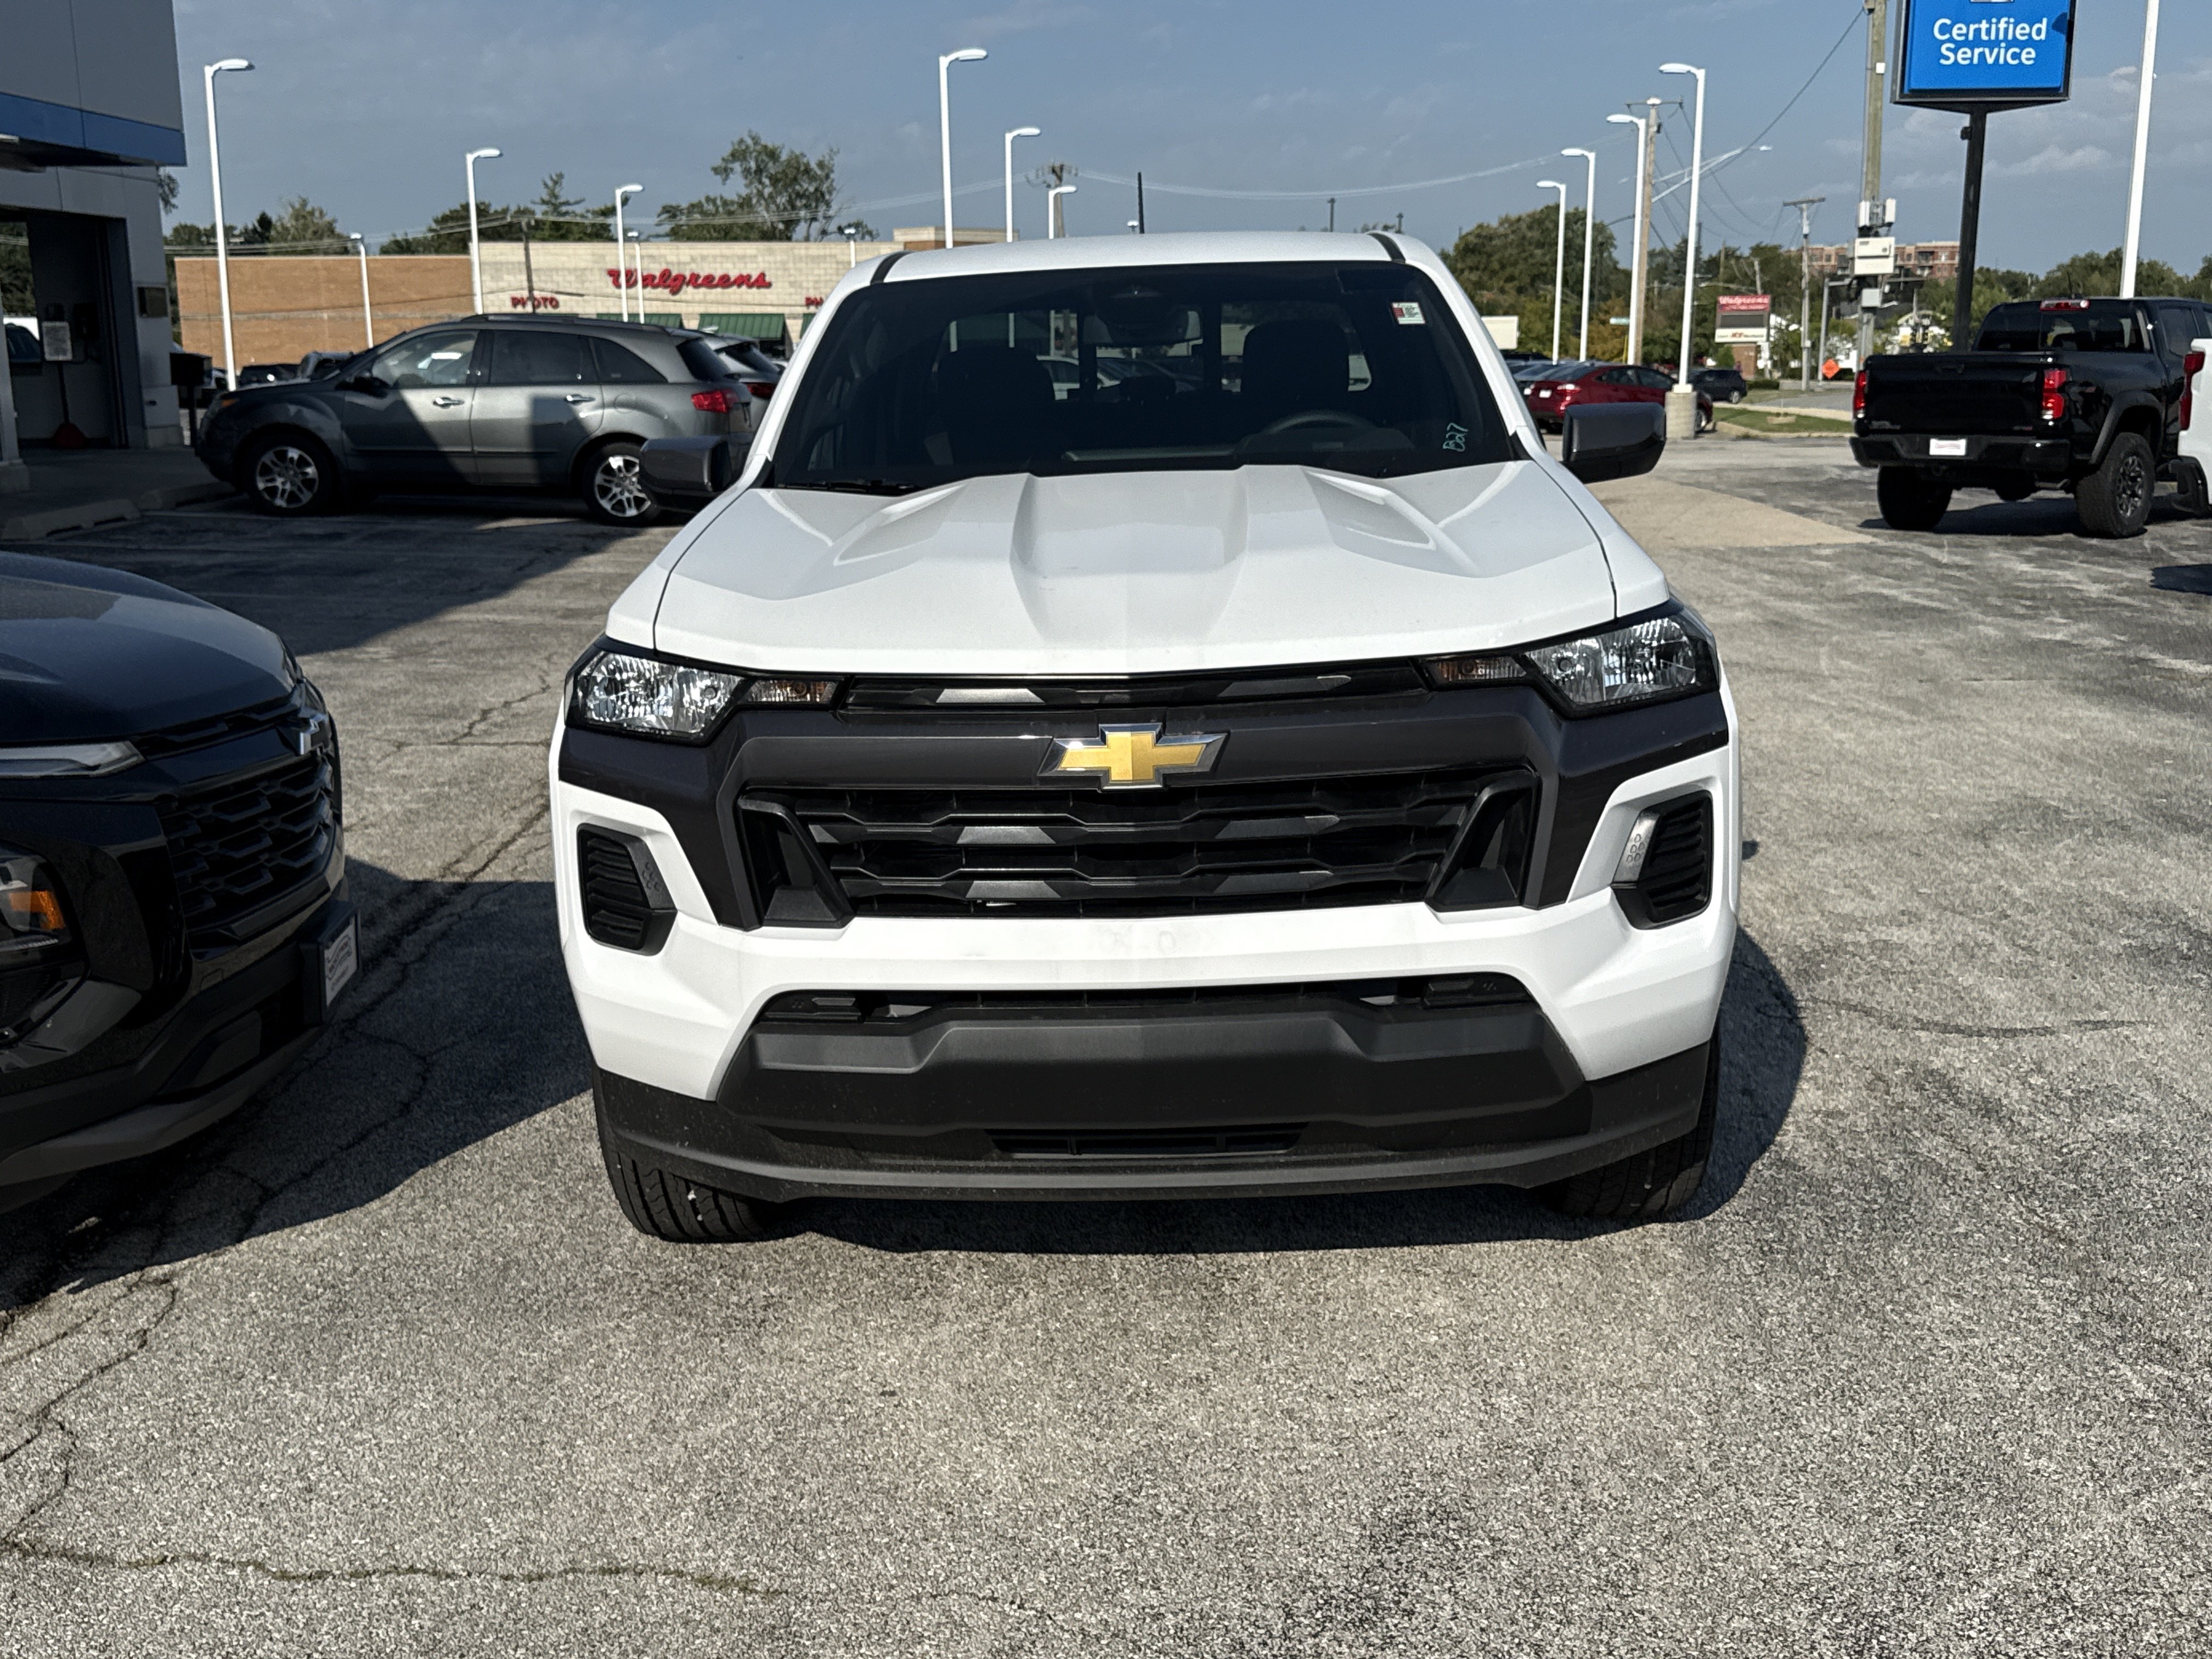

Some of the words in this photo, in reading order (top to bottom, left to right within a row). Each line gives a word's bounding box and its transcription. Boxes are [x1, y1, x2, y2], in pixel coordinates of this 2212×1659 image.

[1933, 17, 2047, 41] Certified
[1939, 43, 2036, 65] Service
[607, 268, 772, 296] Walgreens
[511, 296, 560, 309] PHOTO
[1442, 422, 1469, 452] B27
